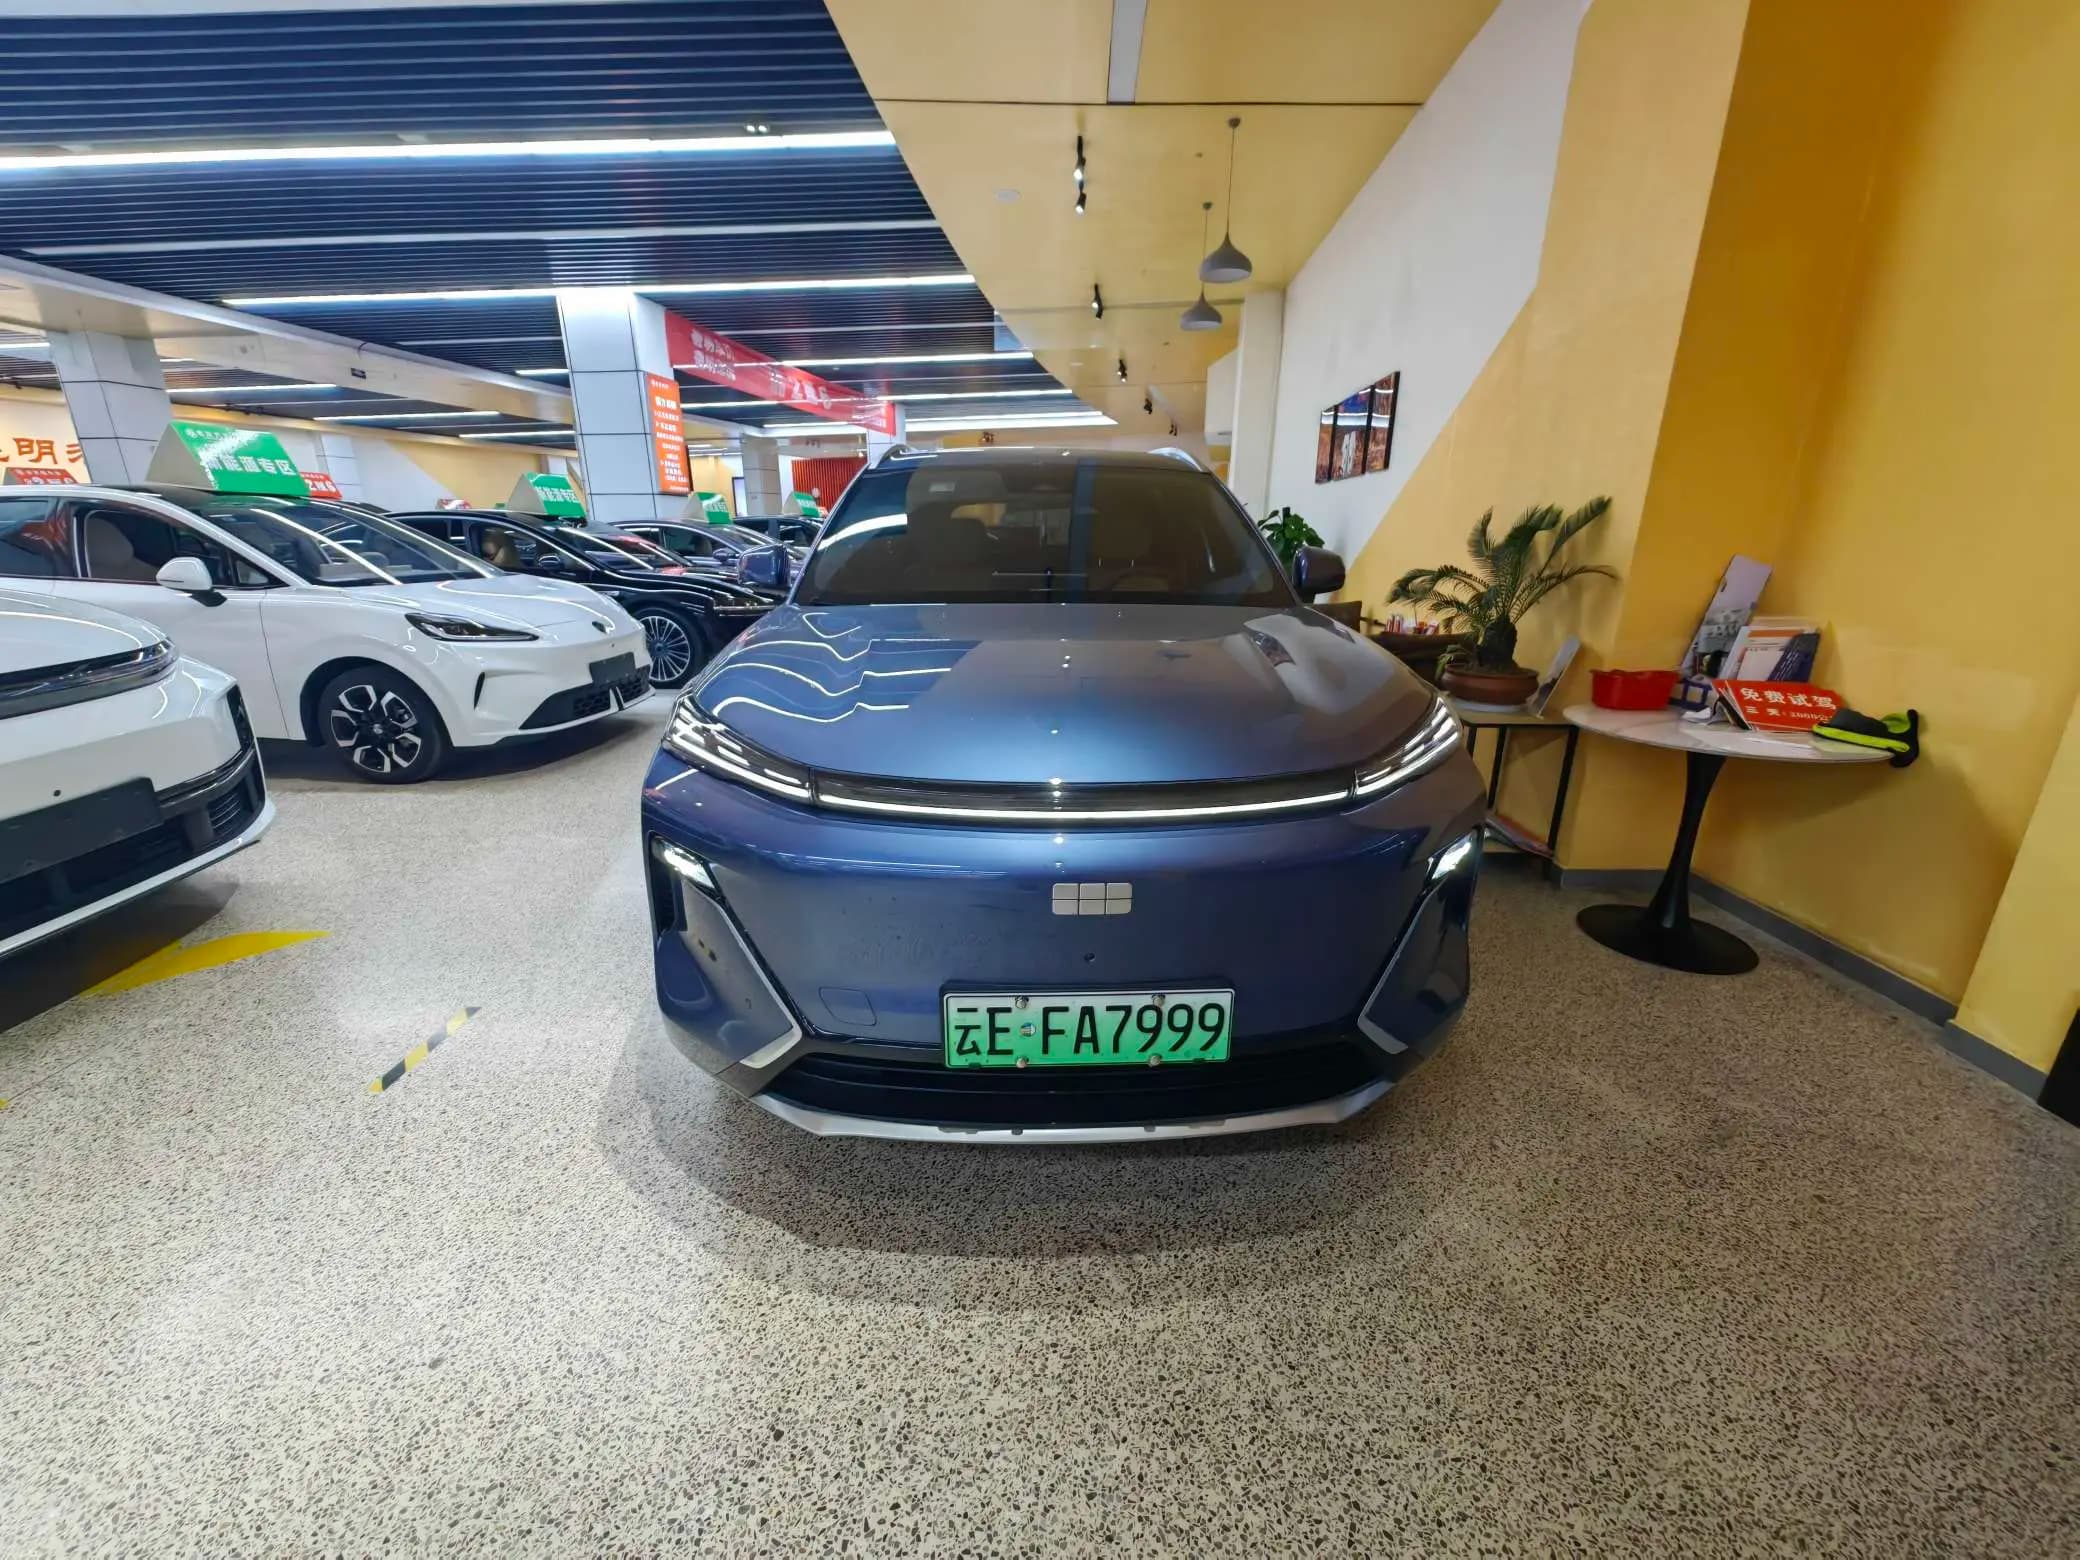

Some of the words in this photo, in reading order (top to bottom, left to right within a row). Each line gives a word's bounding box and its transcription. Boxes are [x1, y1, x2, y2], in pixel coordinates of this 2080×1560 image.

[1740, 687, 1836, 709] 免费试驾
[1041, 1002, 1225, 1055] FA7999
